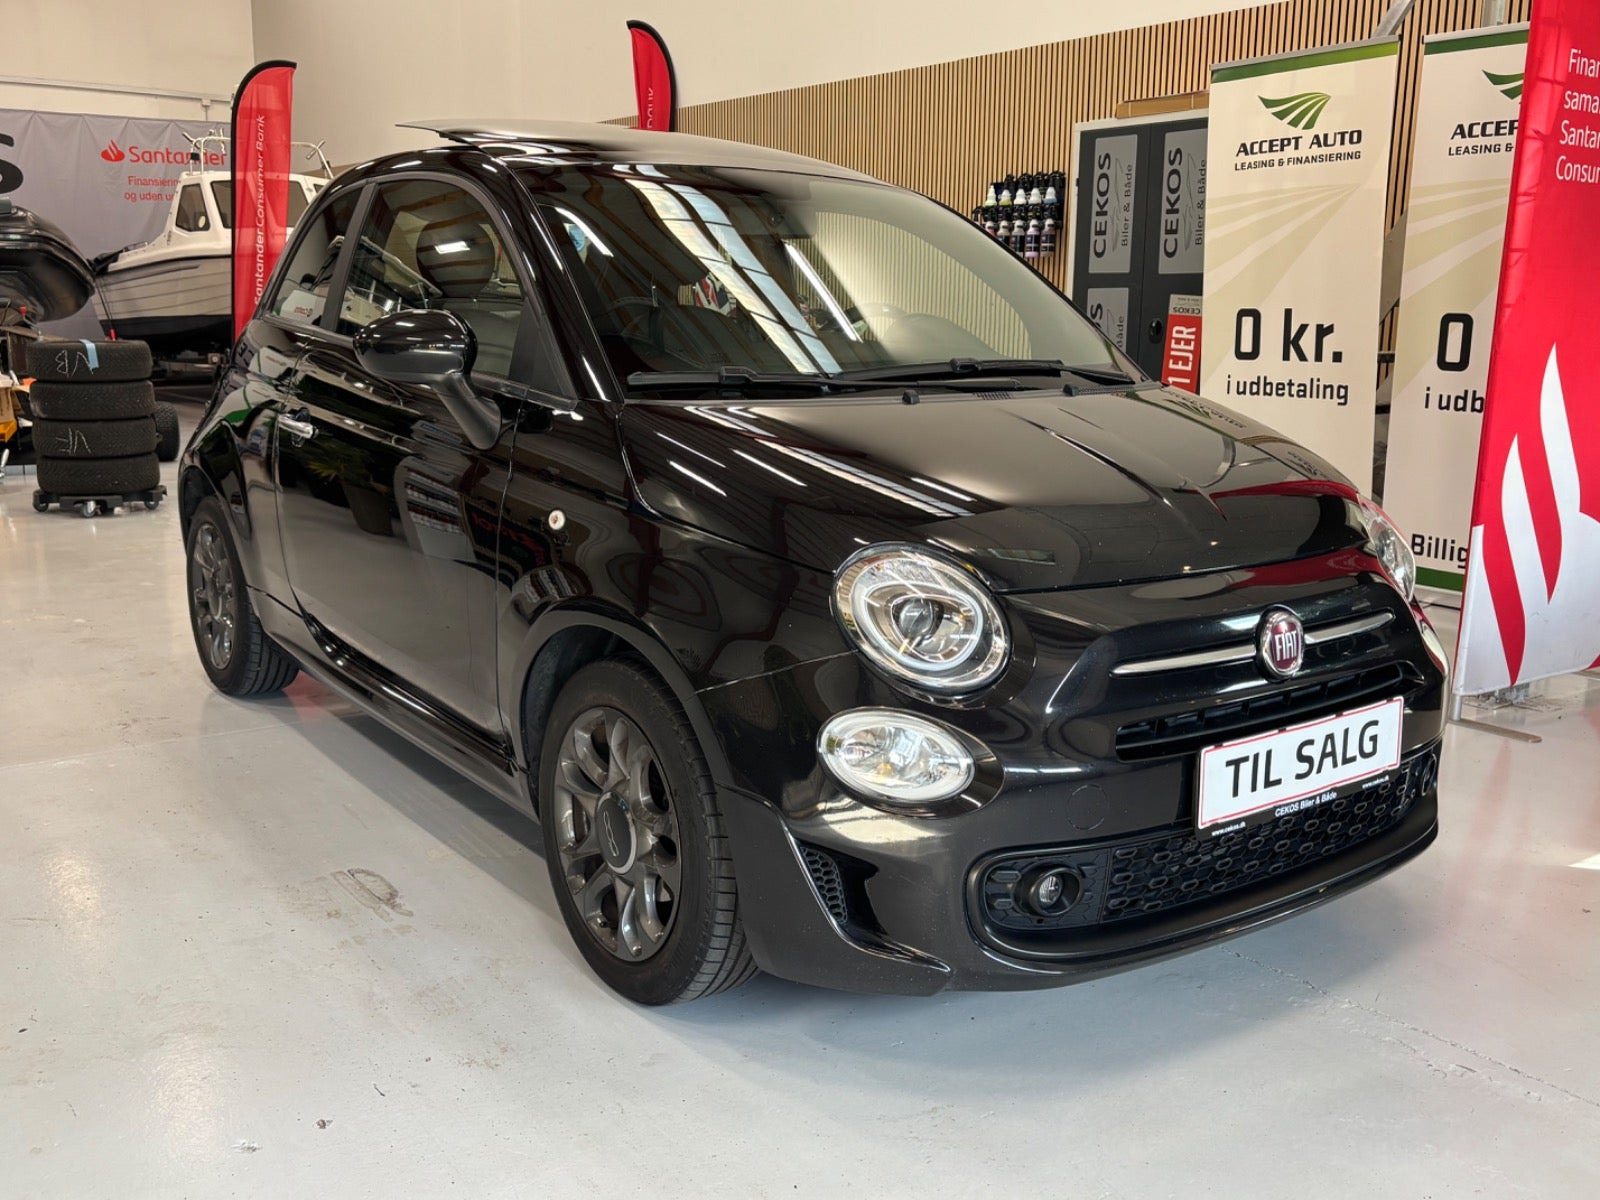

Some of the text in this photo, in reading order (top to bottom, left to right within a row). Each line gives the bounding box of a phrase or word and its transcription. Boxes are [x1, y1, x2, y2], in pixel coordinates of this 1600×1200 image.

[1563, 90, 1600, 114] sama
[256, 115, 265, 151] Bank
[1235, 129, 1362, 157] ACCEPT AUTO
[1448, 142, 1514, 156] LEASING &
[1234, 150, 1361, 172] LEASING & FINANSIERING
[124, 192, 137, 203] og
[140, 192, 163, 201] uden
[256, 153, 266, 229] Consumer
[1093, 152, 1111, 259] CEKOS
[1121, 164, 1133, 247] Biler & Både
[1163, 147, 1183, 259] CEKOS
[1195, 159, 1207, 246] Biler & Både
[1168, 325, 1197, 371] EJER
[1234, 308, 1343, 363] 0 kr.
[1436, 312, 1474, 372] 0
[1167, 376, 1191, 384] 1
[1227, 374, 1349, 406] i udbetaling
[1424, 386, 1485, 413] i udb
[1411, 533, 1468, 569] Billig
[1274, 630, 1297, 662] FIAT
[1225, 719, 1379, 798] TIL SALG
[1274, 802, 1299, 817] CEKOS
